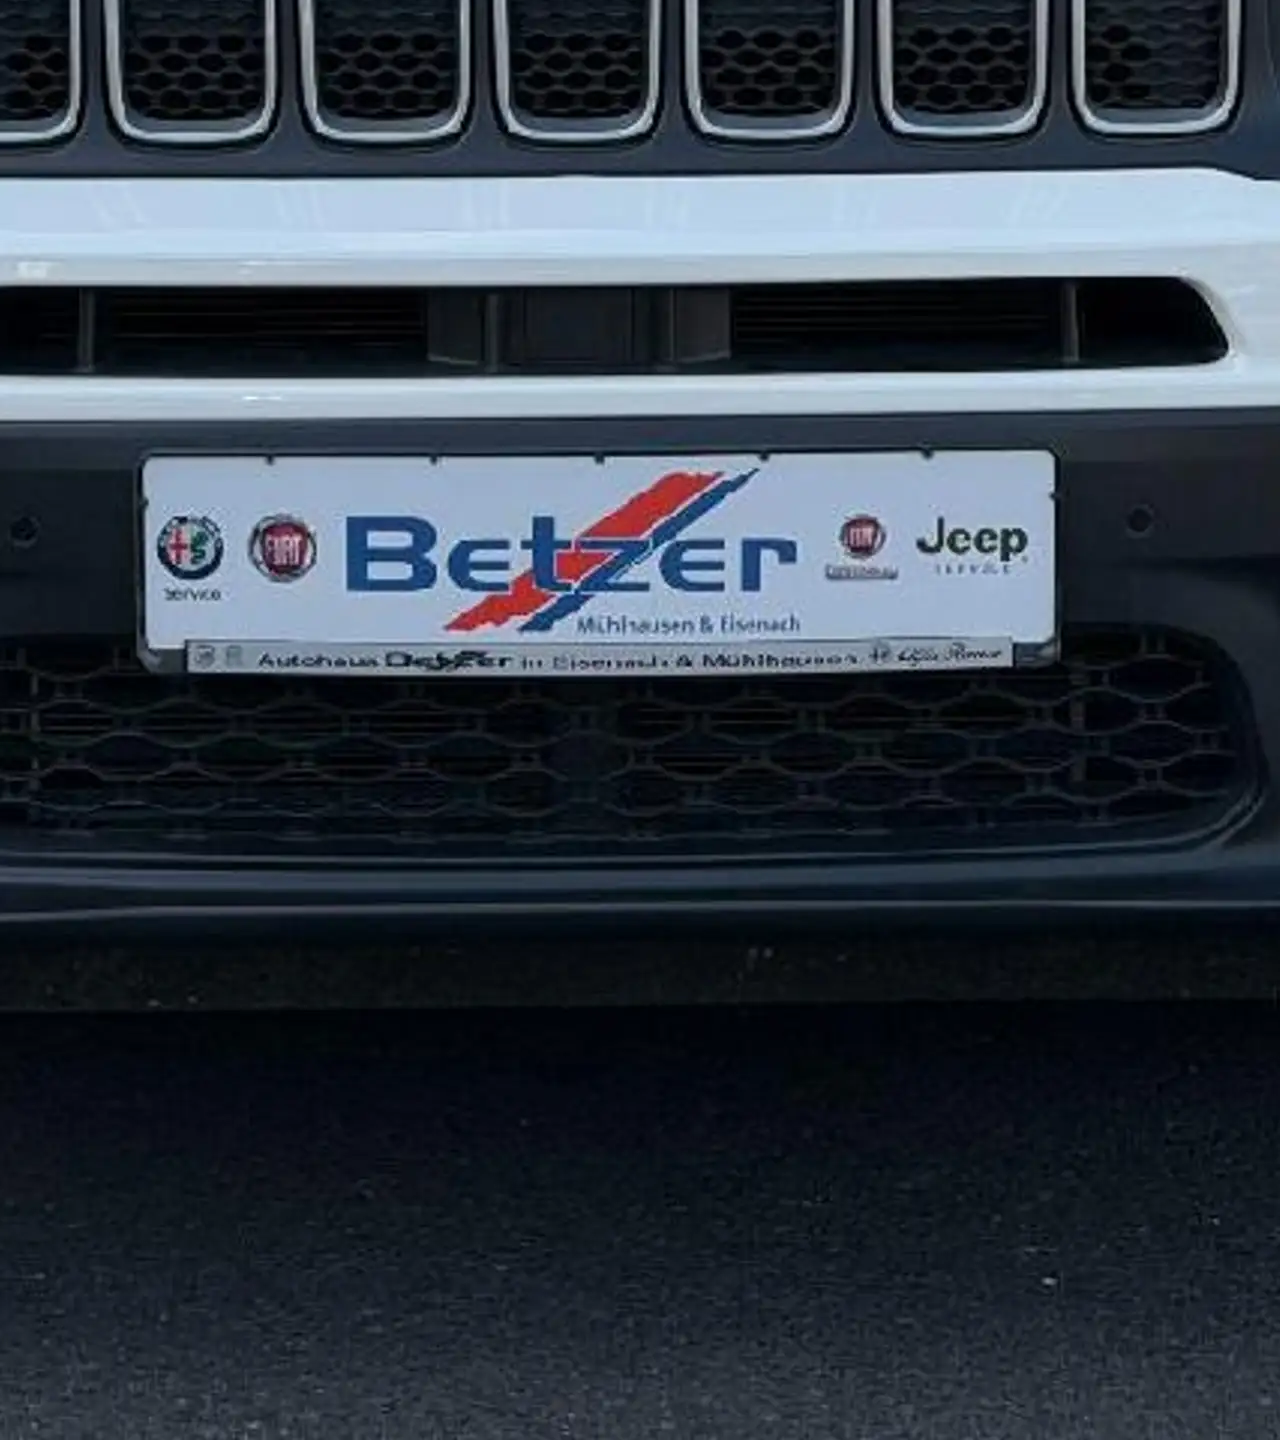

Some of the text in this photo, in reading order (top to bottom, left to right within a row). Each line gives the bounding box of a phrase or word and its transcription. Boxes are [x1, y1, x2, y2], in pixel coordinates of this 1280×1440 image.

[266, 534, 304, 564] FIAT
[346, 517, 797, 591] Betzer
[916, 516, 1028, 562] Jeep
